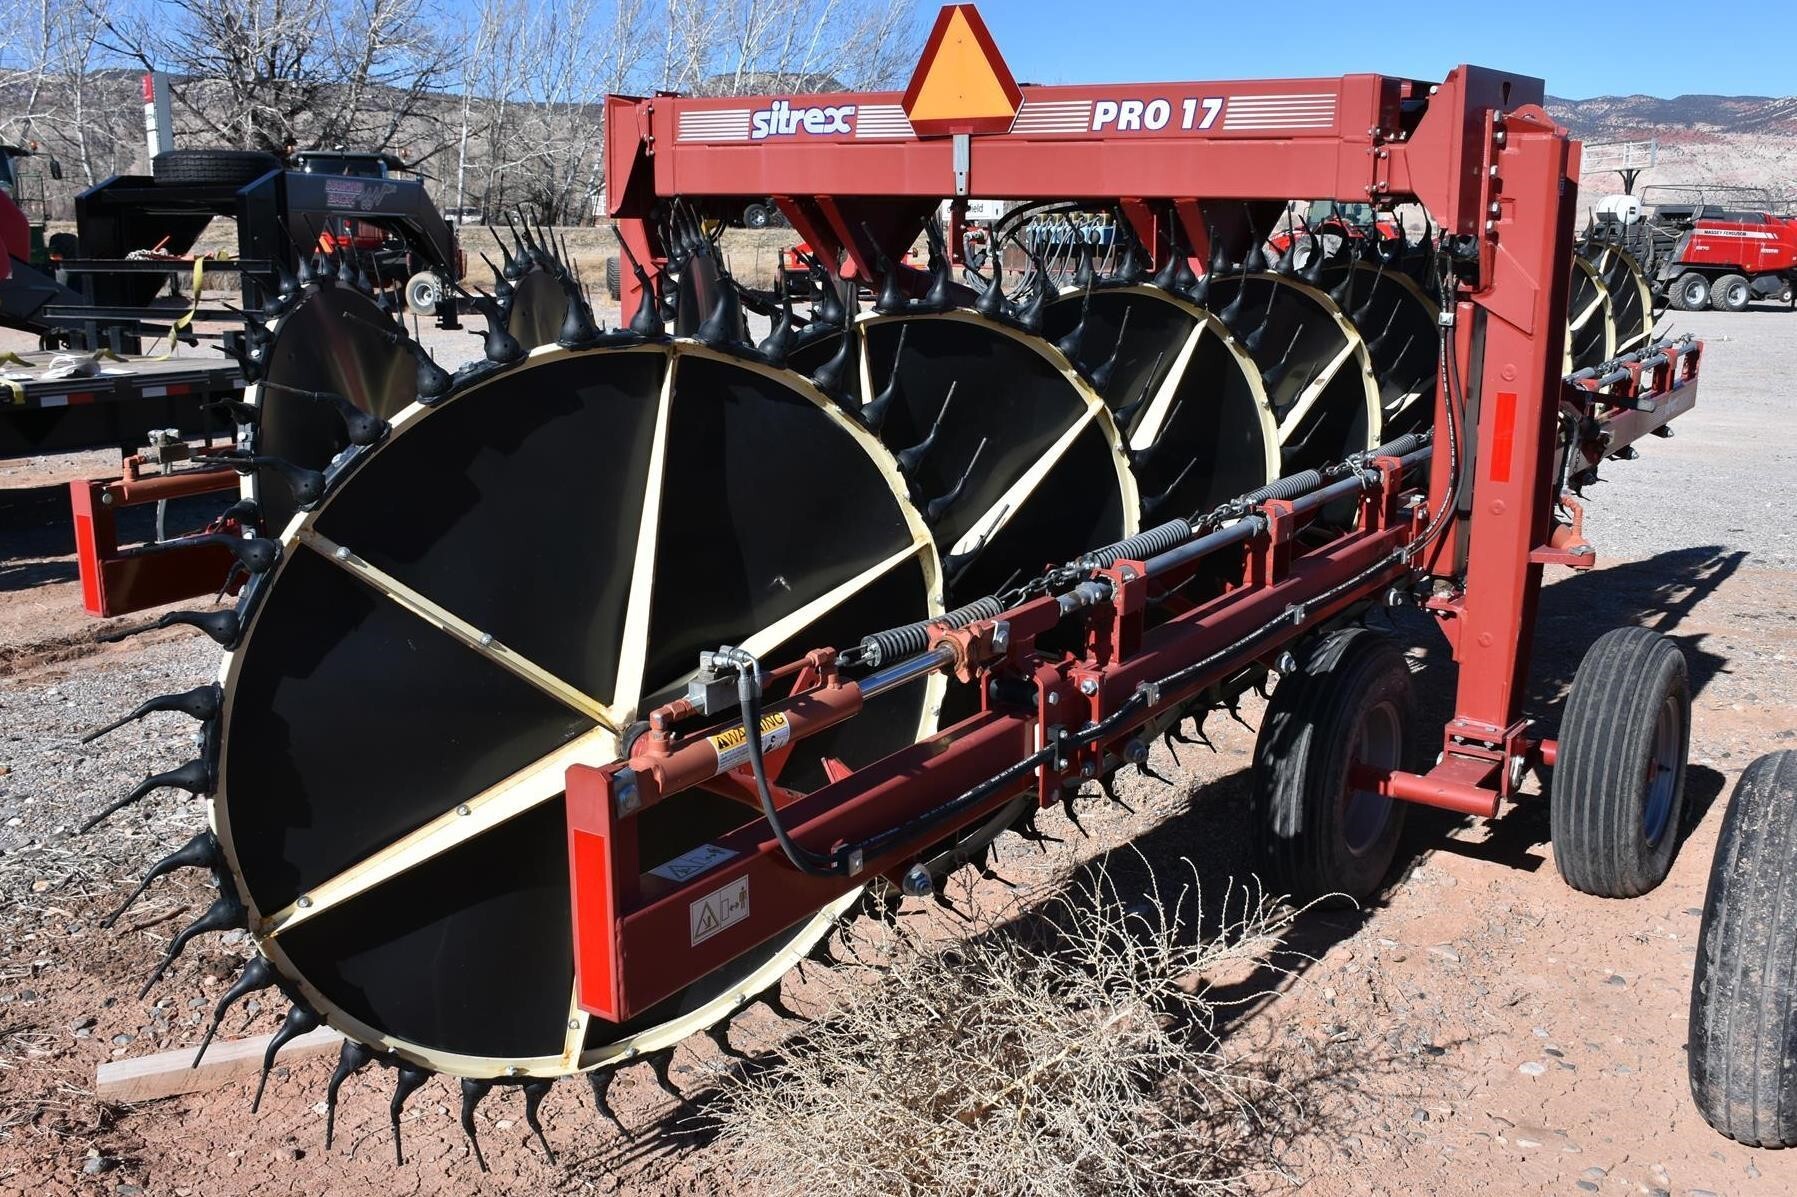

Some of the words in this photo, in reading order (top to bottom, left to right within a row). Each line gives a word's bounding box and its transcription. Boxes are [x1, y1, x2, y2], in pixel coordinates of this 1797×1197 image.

[751, 100, 856, 139] sitrex
[1090, 98, 1171, 131] PRO
[1181, 97, 1224, 130] 17
[724, 712, 785, 746] WAING
